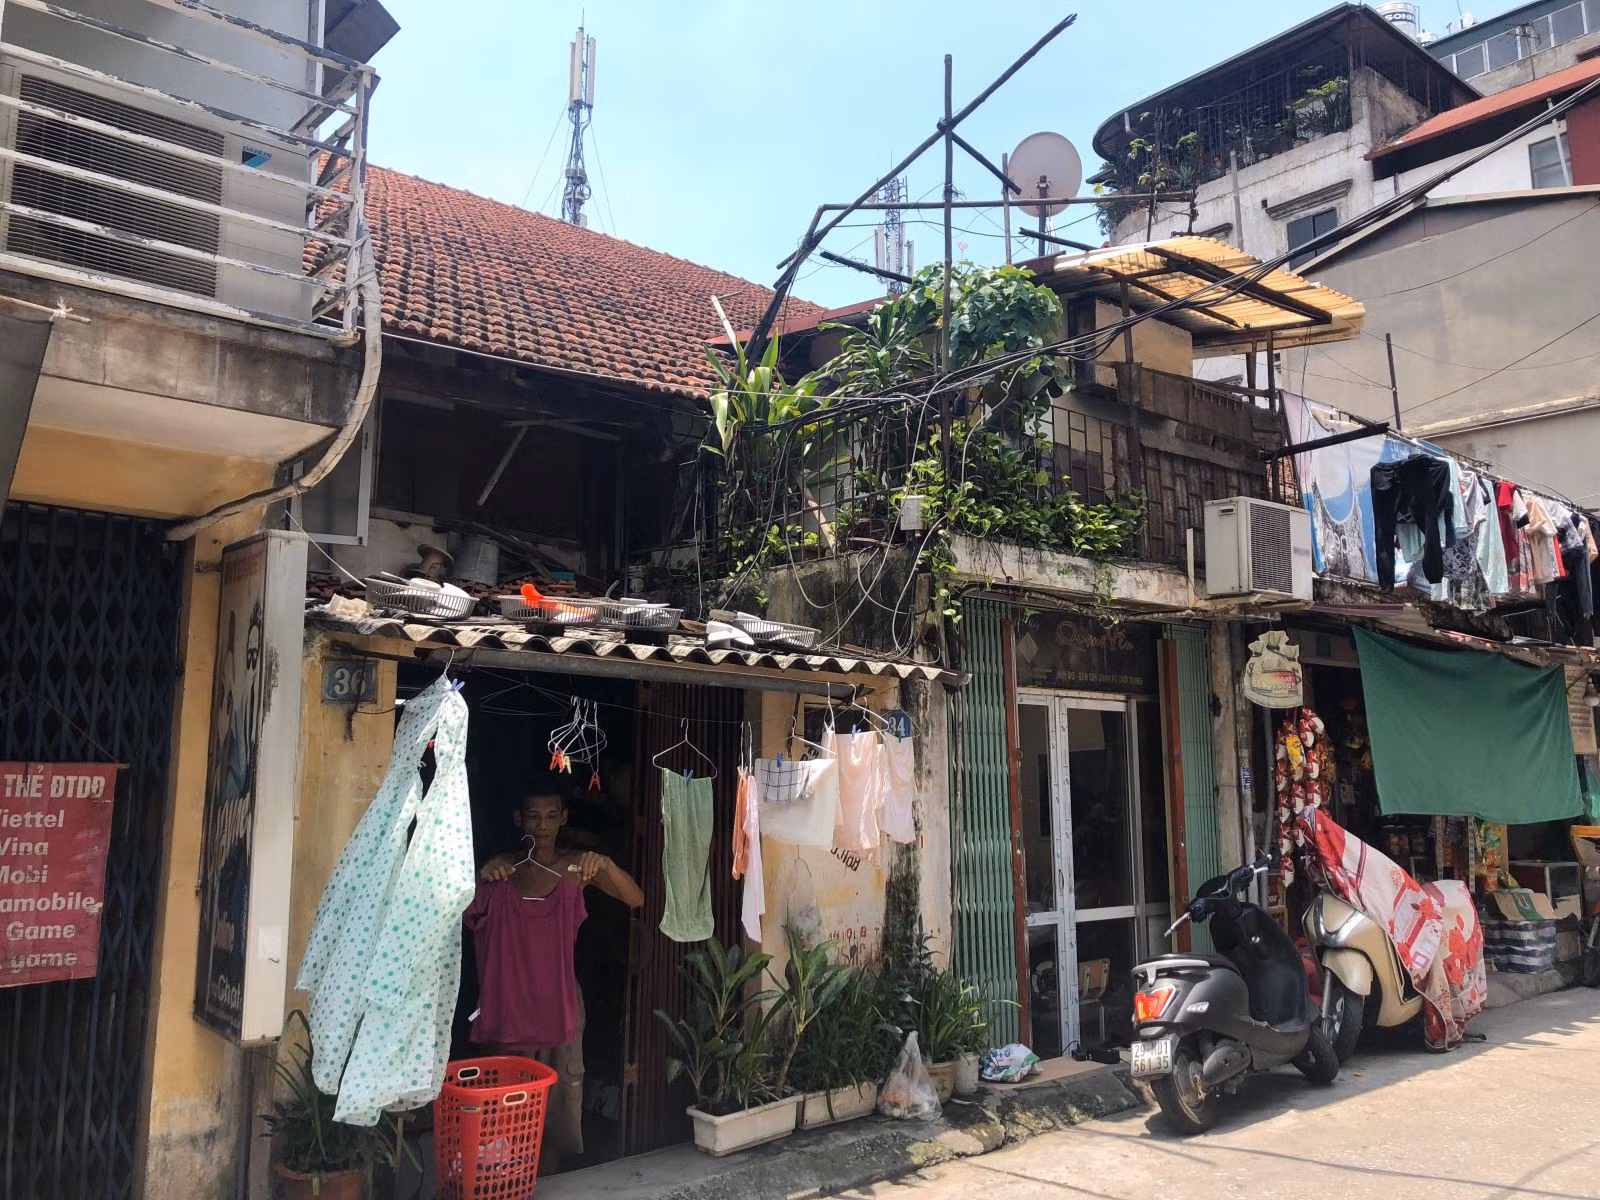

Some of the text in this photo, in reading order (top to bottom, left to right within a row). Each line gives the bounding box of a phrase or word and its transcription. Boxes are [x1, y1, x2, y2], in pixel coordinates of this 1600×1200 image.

[888, 716, 906, 737] 34
[0, 808, 65, 828] iettel
[6, 920, 77, 941] Game
[10, 952, 78, 974] game
